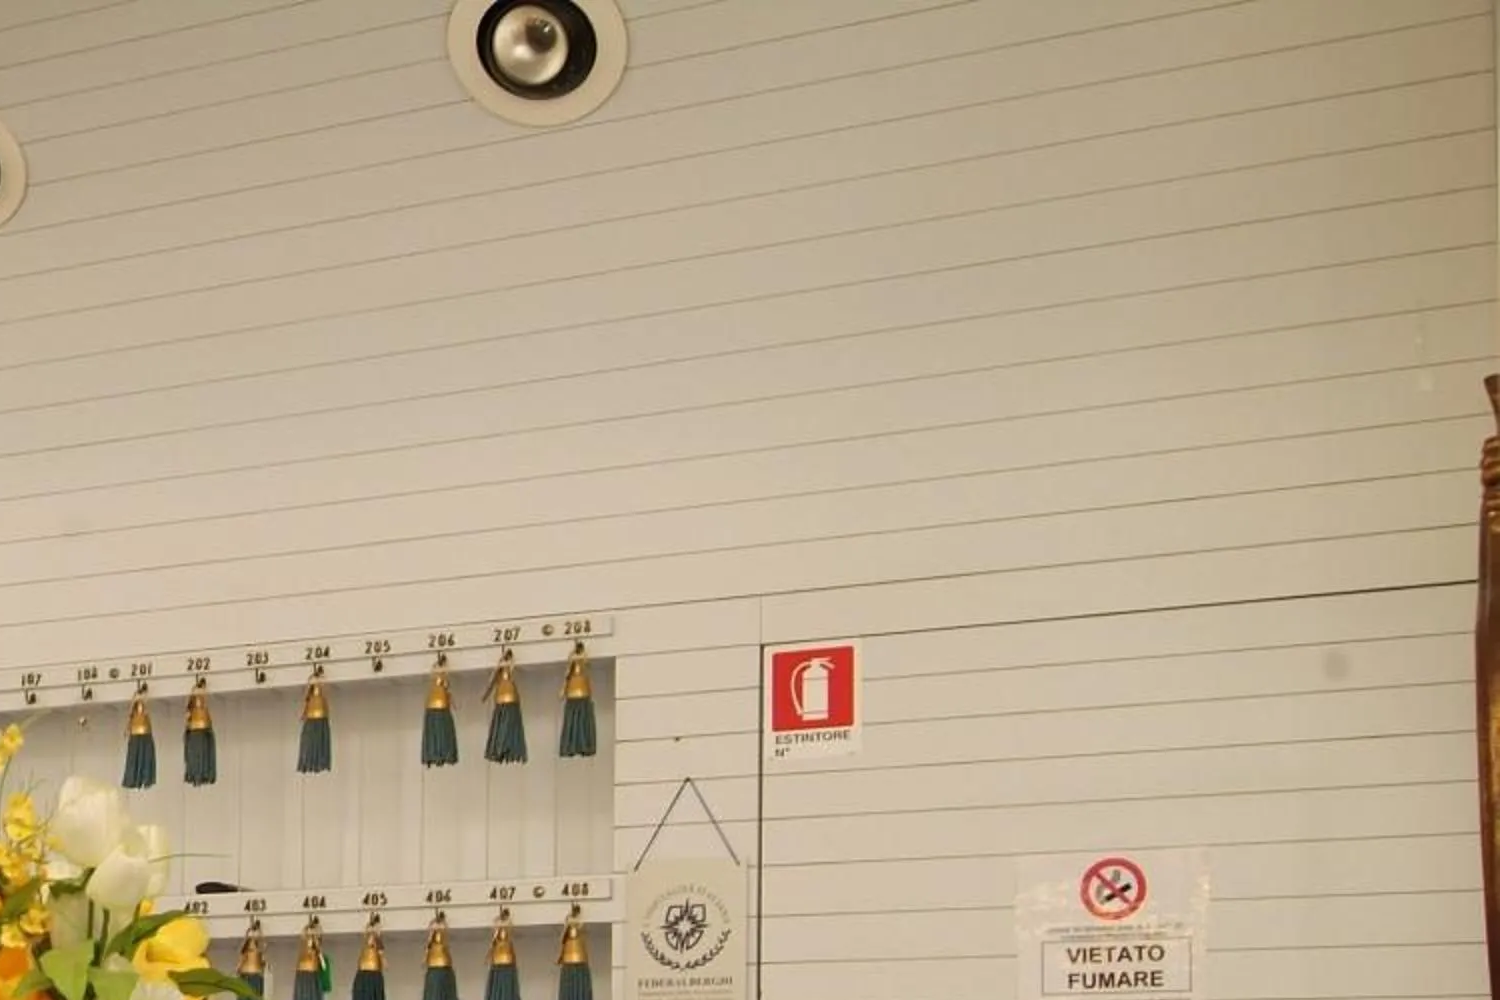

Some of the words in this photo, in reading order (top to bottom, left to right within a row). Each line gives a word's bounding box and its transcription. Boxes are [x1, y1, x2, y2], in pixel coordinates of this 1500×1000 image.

[21, 674, 42, 687] 107
[131, 663, 153, 677] 201
[187, 657, 211, 672] 202
[247, 652, 270, 666] 203
[306, 646, 330, 660] 204
[365, 640, 390, 655] 205
[428, 634, 455, 649] 206
[493, 627, 521, 643] 207
[565, 621, 592, 636] 208
[775, 730, 850, 744] ESTINTORE
[244, 899, 268, 912] 403
[303, 895, 327, 909] 404
[362, 893, 388, 906] 405
[426, 890, 452, 904] 406
[489, 886, 517, 900] 407
[562, 883, 589, 897] 408
[1067, 944, 1165, 965] VIETATO
[637, 976, 733, 989] FEDERALBERGHI
[1068, 970, 1165, 990] FUMARE
